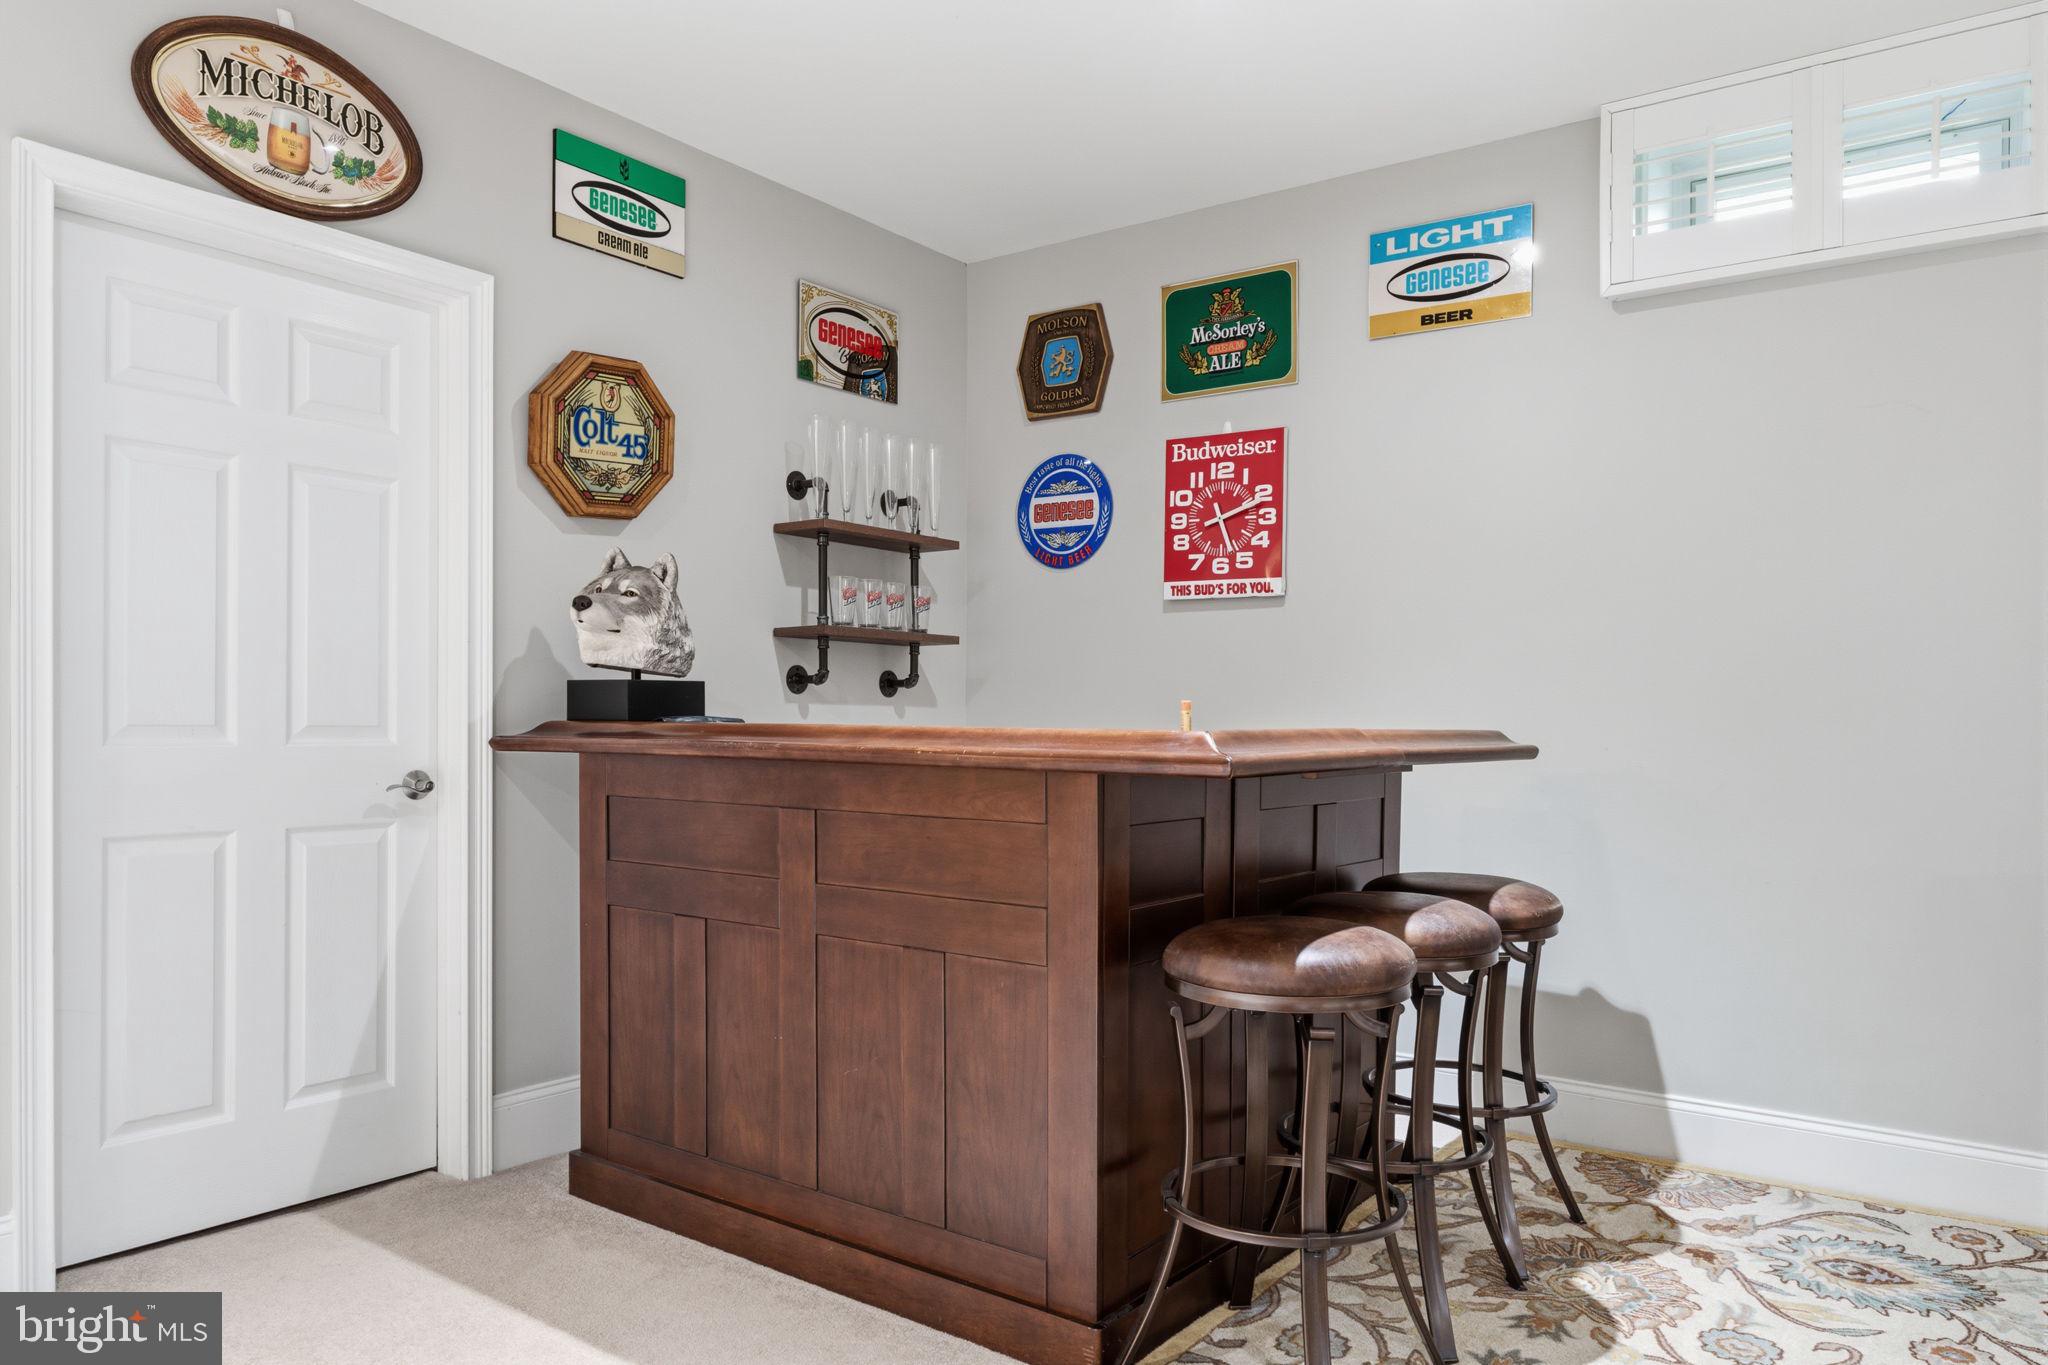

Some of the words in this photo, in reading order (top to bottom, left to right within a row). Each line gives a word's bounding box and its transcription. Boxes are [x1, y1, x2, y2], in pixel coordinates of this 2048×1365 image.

[196, 48, 384, 156] MICHELOB
[1386, 215, 1513, 256] LIGHT
[1037, 316, 1088, 334] MOLSON
[1420, 309, 1473, 326] BEER
[1190, 317, 1266, 345] McSorley's
[1209, 340, 1246, 355] CREAM
[1209, 353, 1242, 372] ALE
[1040, 387, 1083, 402] GOLDEN
[573, 405, 620, 448] Colt
[618, 433, 650, 460] 45
[1172, 438, 1276, 462] Budweiser
[1037, 463, 1054, 477] taste
[1056, 457, 1064, 467] of
[1065, 457, 1076, 466] all
[1076, 459, 1088, 471] the
[1087, 466, 1104, 488] lights
[1210, 462, 1235, 480] 12
[1243, 468, 1249, 485] 1
[1190, 472, 1203, 488] 11
[1170, 490, 1193, 507] 10
[1254, 484, 1273, 501] 2
[1171, 513, 1187, 530] 9
[1258, 508, 1277, 525] 3
[1173, 534, 1190, 551] 8
[1251, 531, 1270, 548] 4
[1034, 547, 1063, 568] LIGHT
[1068, 544, 1093, 566] BEER
[1188, 554, 1206, 571] 7
[1235, 552, 1254, 569] 5
[1212, 557, 1229, 574] 6
[1170, 585, 1191, 596] THIS
[1194, 583, 1224, 596] BUD'S
[1226, 582, 1248, 595] FOR
[1249, 581, 1274, 594] YOU.
